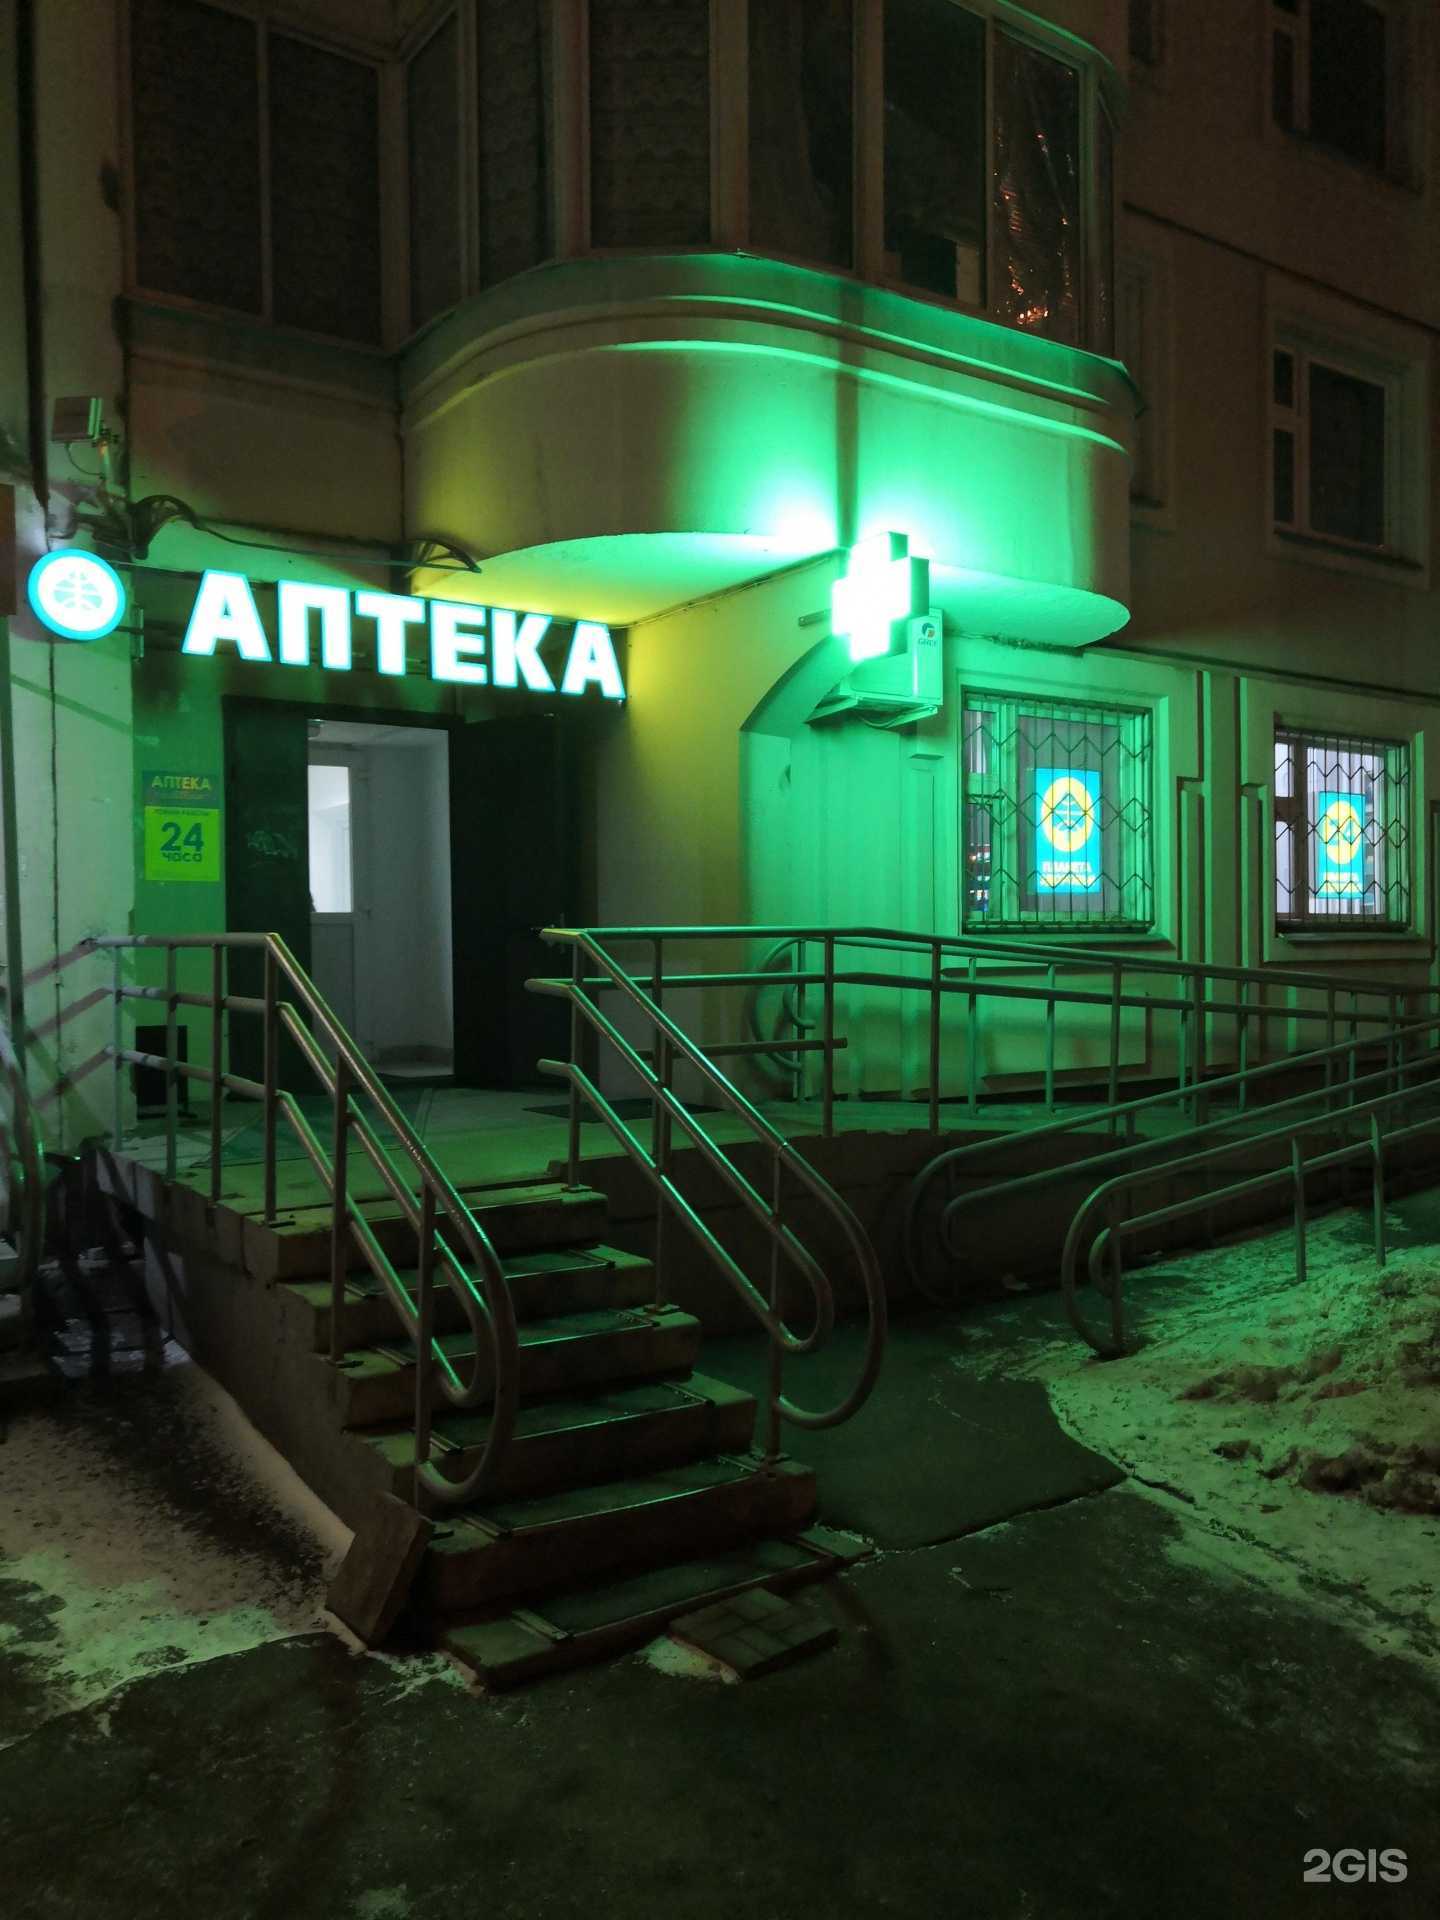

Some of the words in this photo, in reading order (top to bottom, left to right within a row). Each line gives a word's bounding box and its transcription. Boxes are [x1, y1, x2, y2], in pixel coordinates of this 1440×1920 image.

[181, 568, 627, 699] АПТЕКА
[151, 775, 211, 790] АПТЕКА
[160, 821, 204, 852] 24
